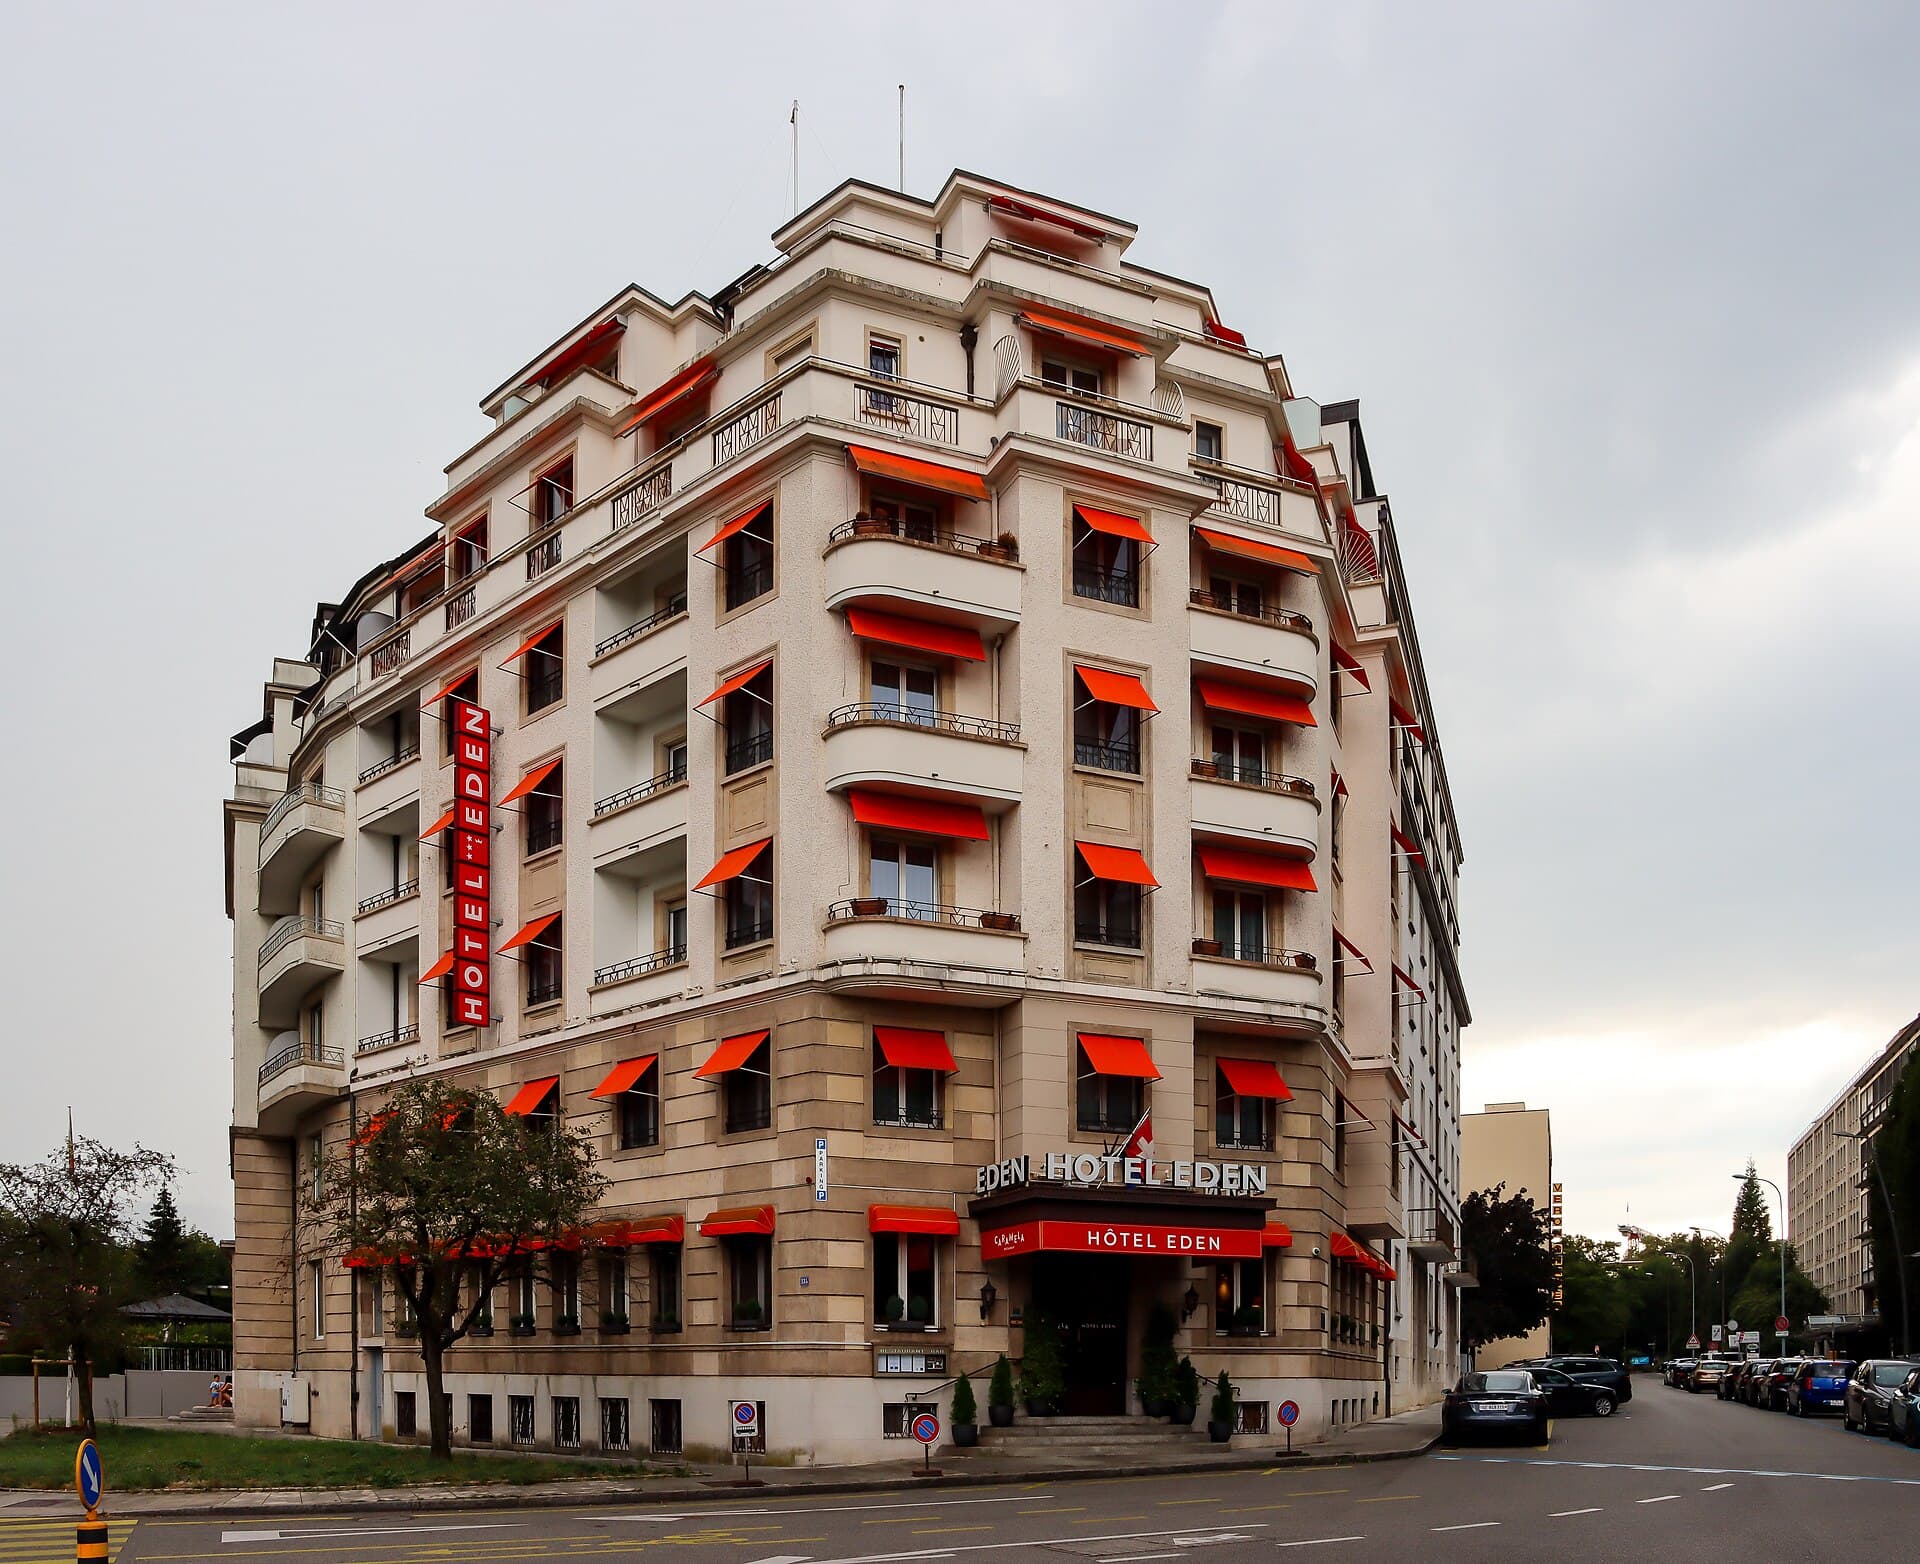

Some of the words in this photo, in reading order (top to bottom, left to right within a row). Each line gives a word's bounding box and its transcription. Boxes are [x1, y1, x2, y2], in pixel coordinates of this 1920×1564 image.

[464, 707, 484, 826] EDEN
[464, 875, 484, 1020] HOTEL
[976, 1155, 1026, 1194] EDEN
[1046, 1152, 1161, 1185] HOTEL
[1173, 1160, 1268, 1192] EDEN
[994, 1231, 1025, 1246] CARAMELA
[1087, 1228, 1157, 1248] HÔTEL
[1167, 1234, 1220, 1251] EDEN
